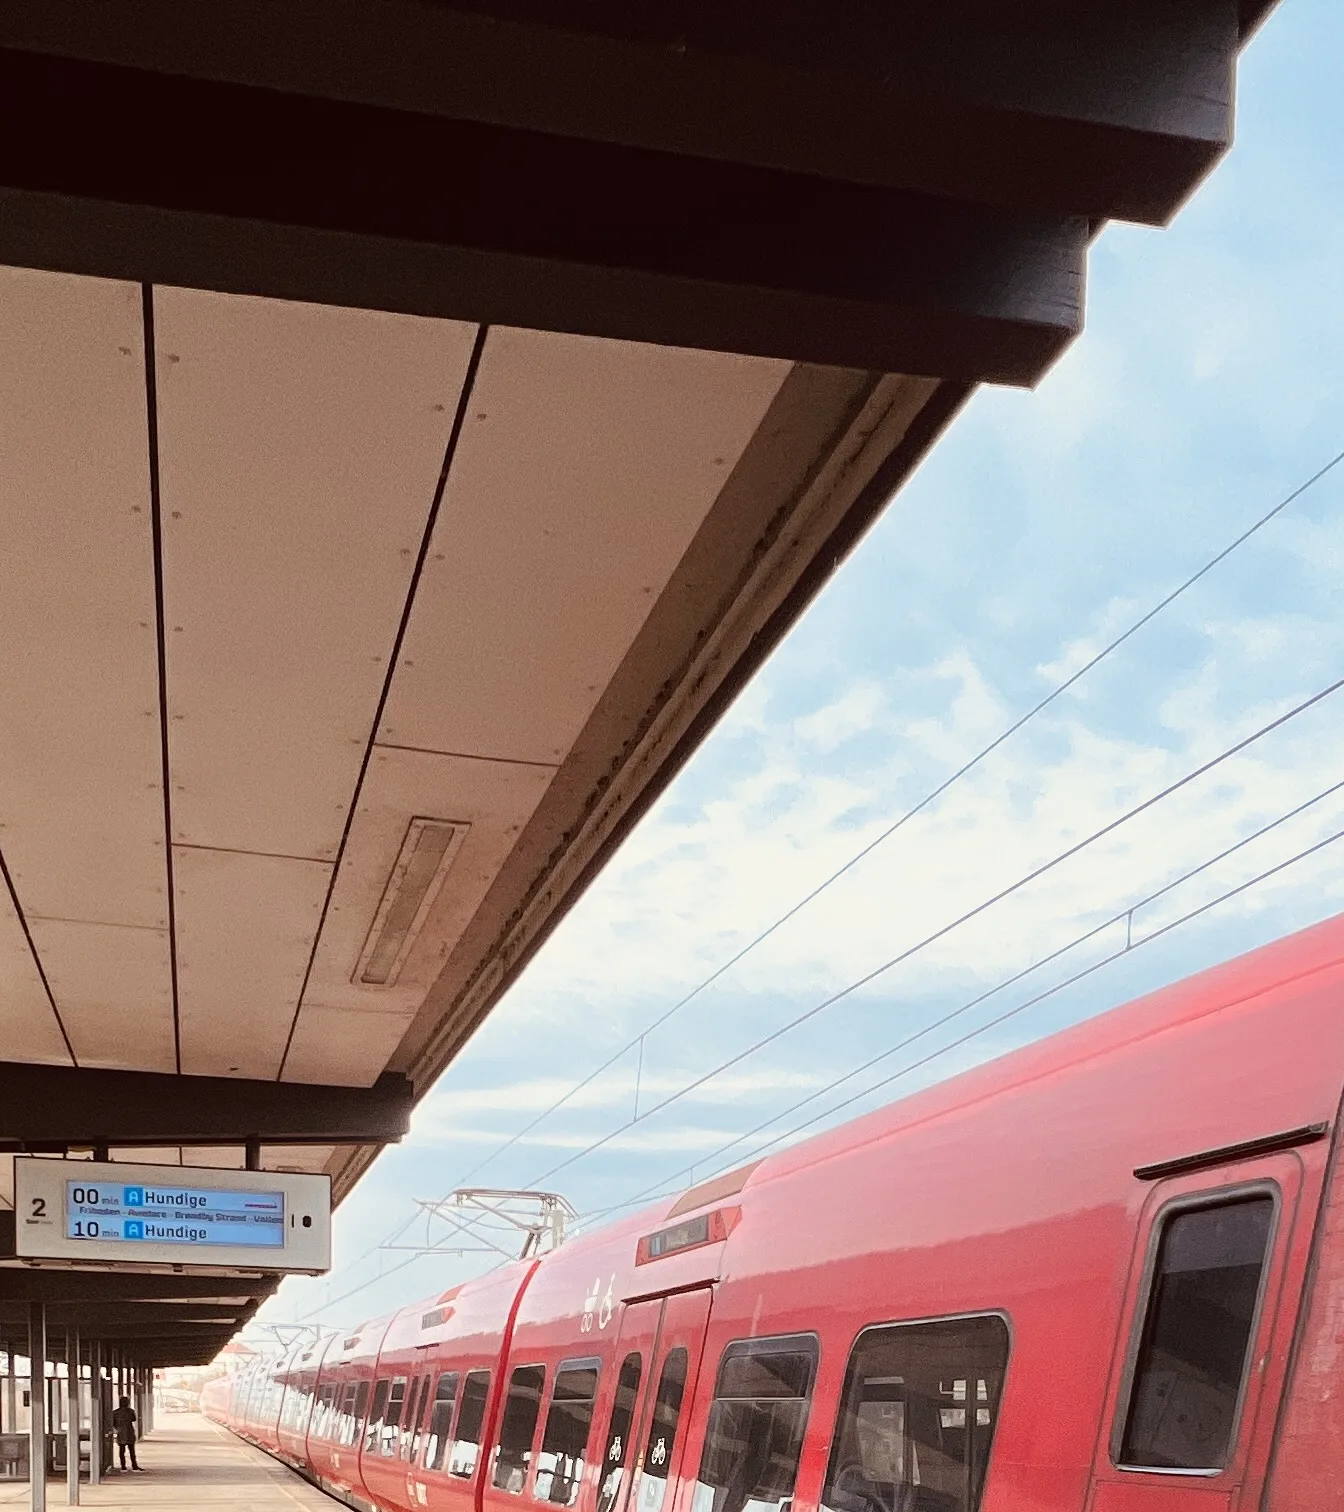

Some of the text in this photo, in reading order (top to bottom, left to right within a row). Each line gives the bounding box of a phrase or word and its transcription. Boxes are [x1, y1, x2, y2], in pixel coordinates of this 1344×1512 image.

[31, 1198, 47, 1217] 2
[72, 1187, 100, 1205] 00
[144, 1190, 208, 1209] Hundige
[73, 1221, 99, 1238] 10
[144, 1224, 208, 1242] Hundige
